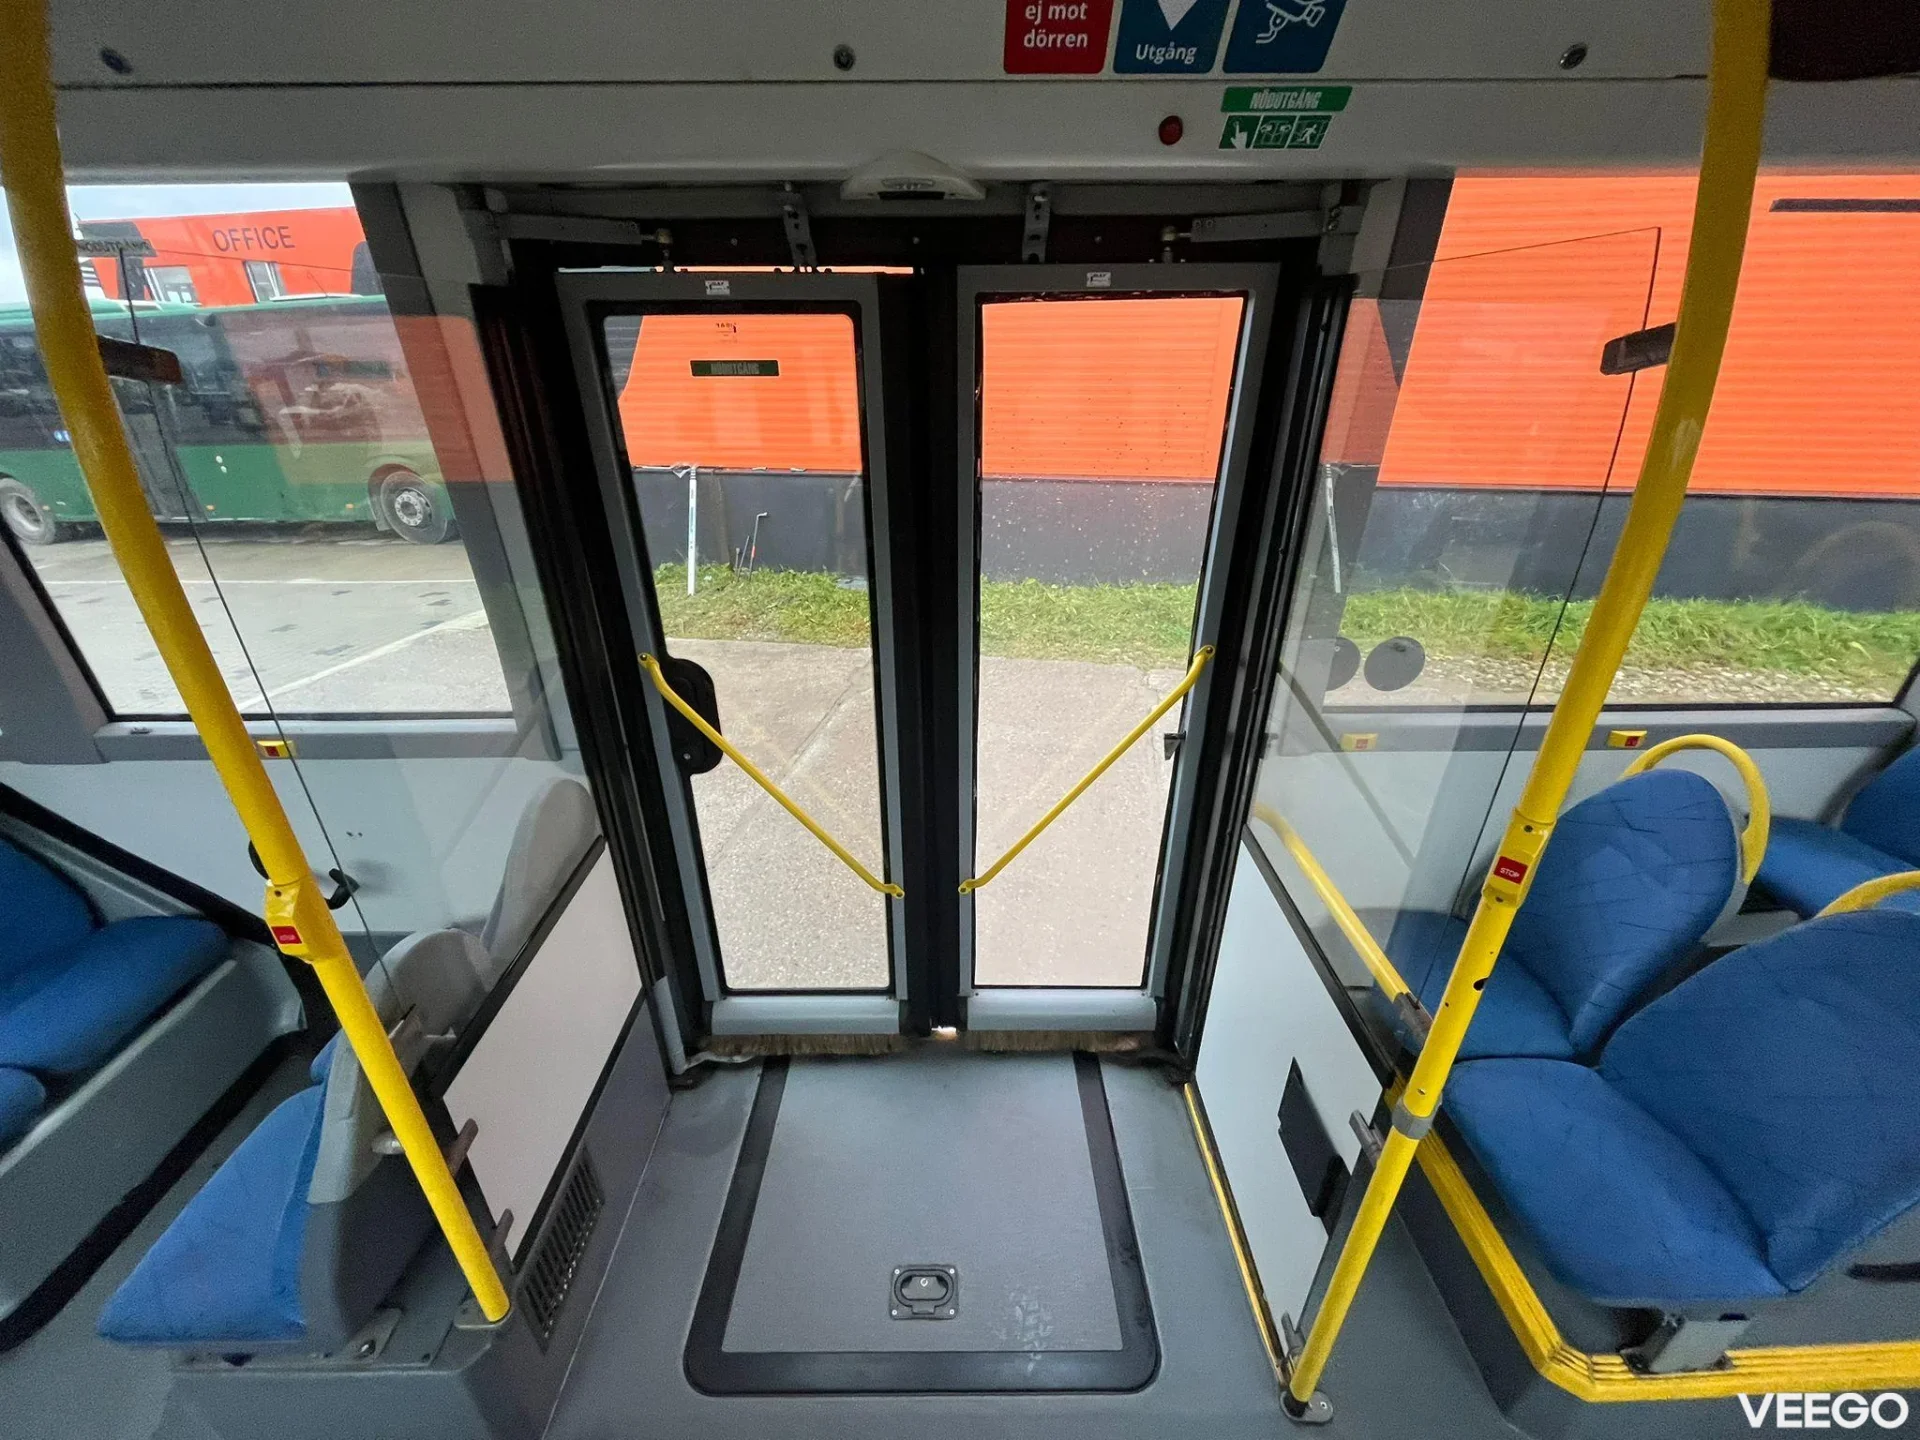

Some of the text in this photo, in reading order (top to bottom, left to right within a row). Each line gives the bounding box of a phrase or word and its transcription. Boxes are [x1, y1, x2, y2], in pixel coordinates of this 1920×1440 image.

[1025, 1, 1088, 25] ej mot
[1023, 29, 1088, 48] dörren
[1135, 42, 1197, 65] Utgång
[1249, 88, 1322, 109] NÖDUTGÅNG
[212, 226, 296, 252] OFFICE
[1500, 867, 1520, 878] STOP
